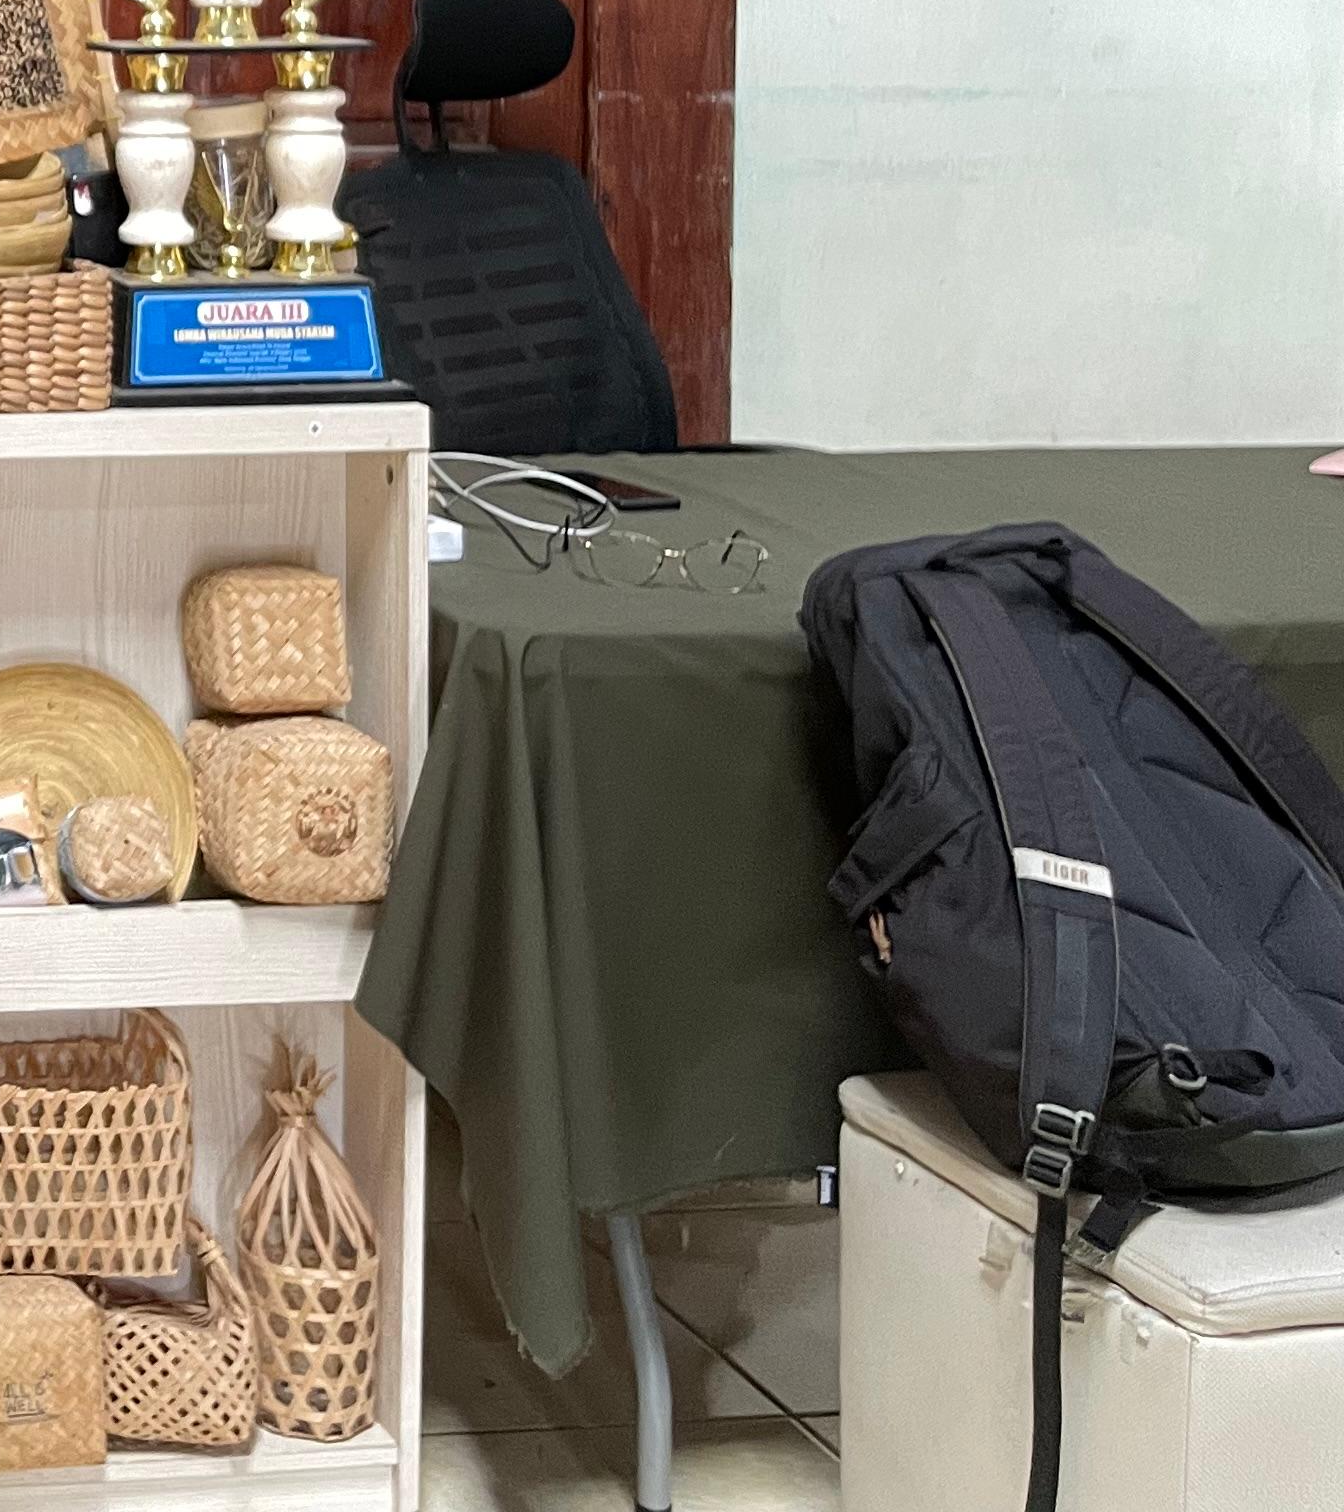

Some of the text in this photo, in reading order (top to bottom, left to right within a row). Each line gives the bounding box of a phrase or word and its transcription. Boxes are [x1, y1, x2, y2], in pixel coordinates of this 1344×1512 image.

[204, 302, 303, 322] JUARA III
[1043, 859, 1088, 886] EIGER
